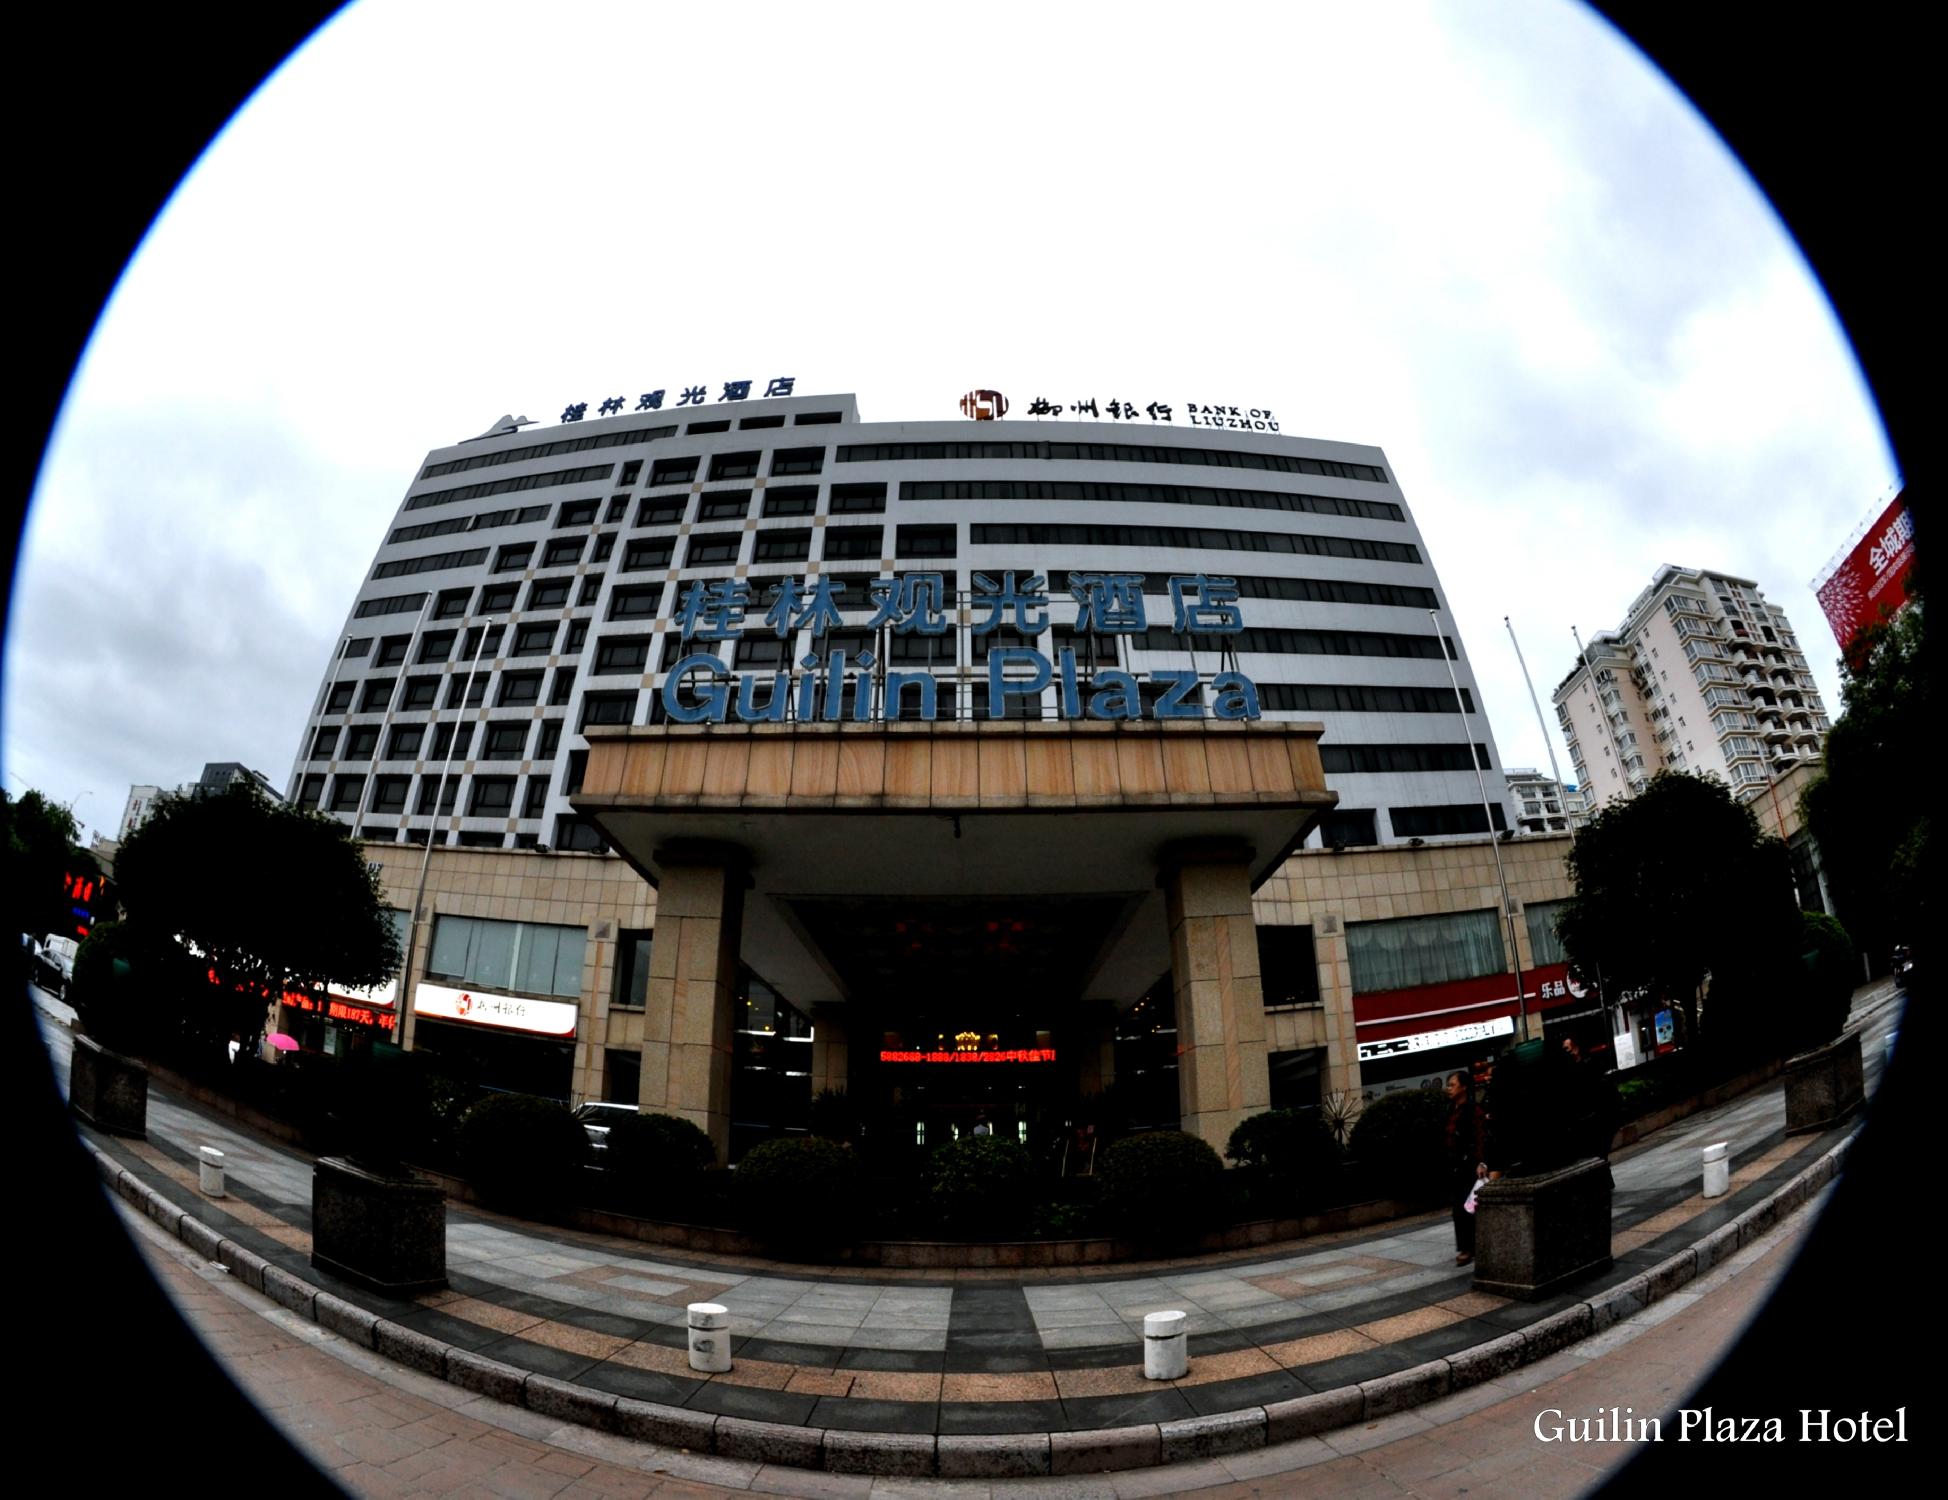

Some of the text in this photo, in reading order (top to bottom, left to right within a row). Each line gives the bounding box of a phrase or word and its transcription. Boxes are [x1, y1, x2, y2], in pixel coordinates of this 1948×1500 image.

[1187, 402, 1271, 420] BANK OF
[1191, 415, 1279, 432] LIUZHOU
[672, 570, 1245, 642] 桂林观光酒店
[661, 645, 1263, 723] Guilin Plaza
